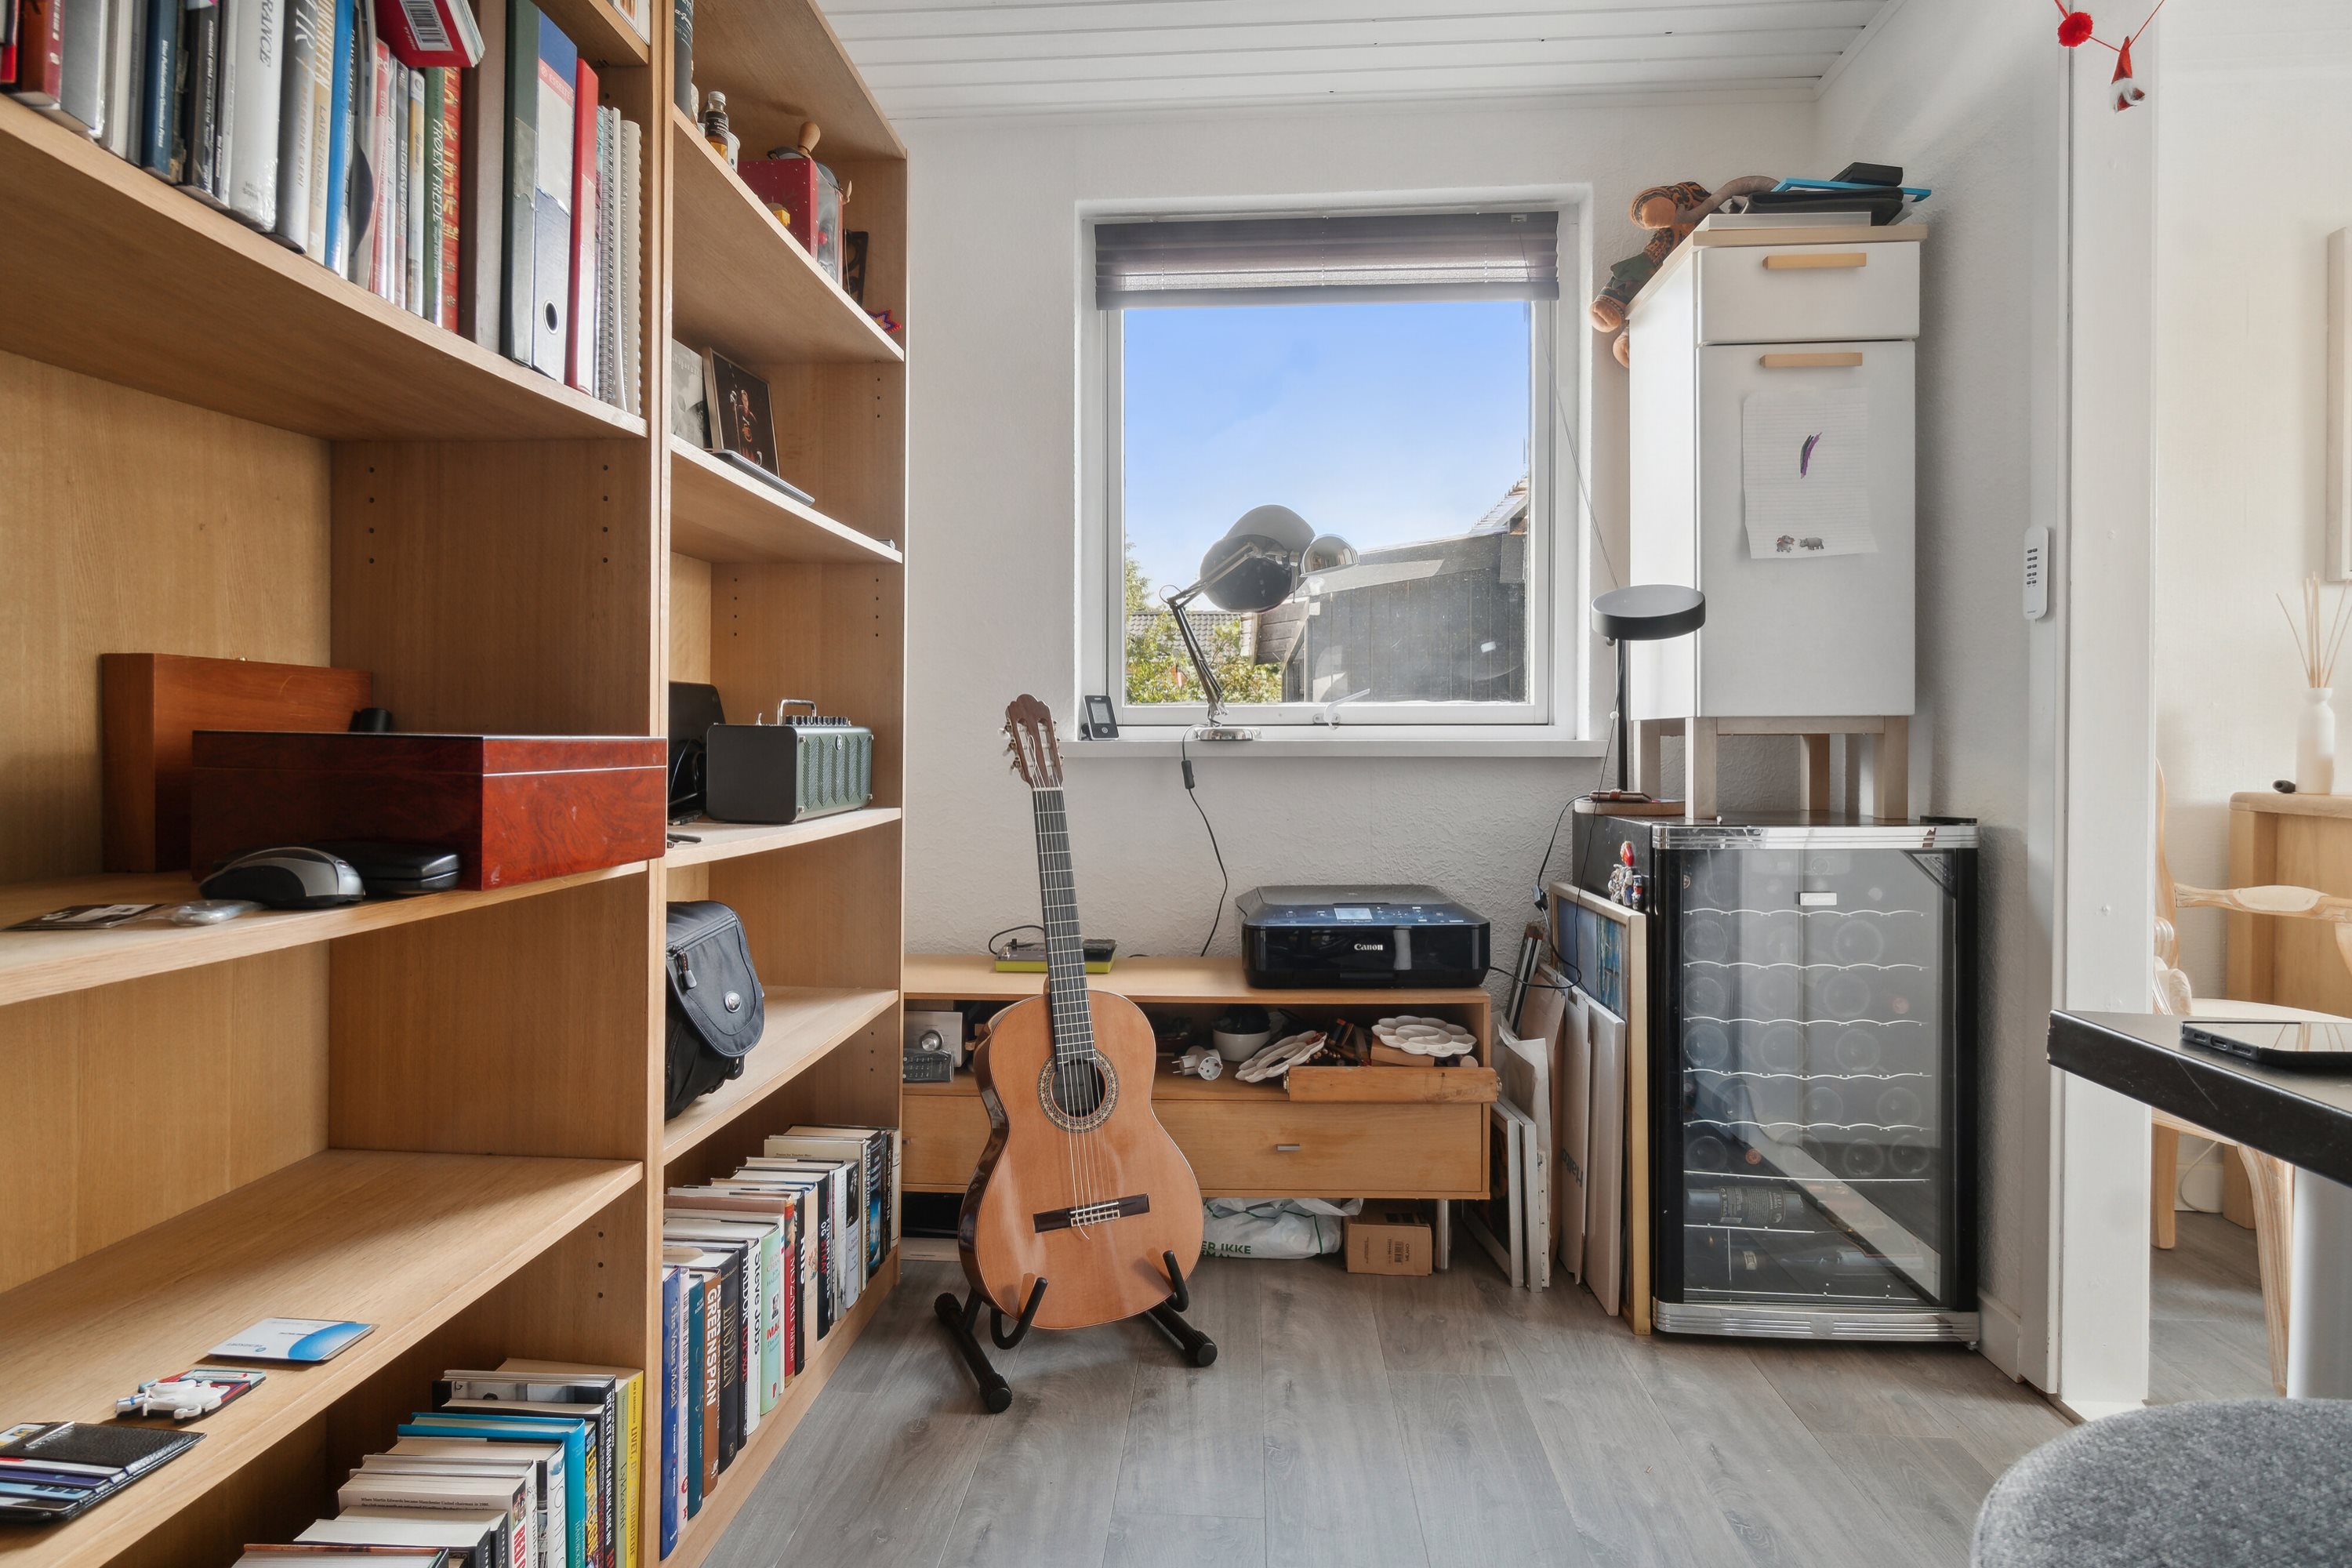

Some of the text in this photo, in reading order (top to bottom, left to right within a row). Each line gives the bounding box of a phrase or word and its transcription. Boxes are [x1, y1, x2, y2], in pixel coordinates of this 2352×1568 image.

[548, 73, 570, 100] ESSELTE
[296, 155, 306, 188] GENI
[316, 105, 328, 210] LARS FINDSEN
[432, 118, 444, 172] FRØEN
[399, 139, 408, 238] SCORPIONS
[432, 172, 444, 227] FREDE
[821, 1221, 827, 1237] OG
[1221, 1243, 1251, 1254] IKKE
[706, 1288, 717, 1406] GREENSPAN
[723, 1300, 737, 1388] EINSTEIN
[550, 1477, 564, 1553] JOHN
[619, 1462, 627, 1532] Lykketoft
[514, 1523, 526, 1565] RED
